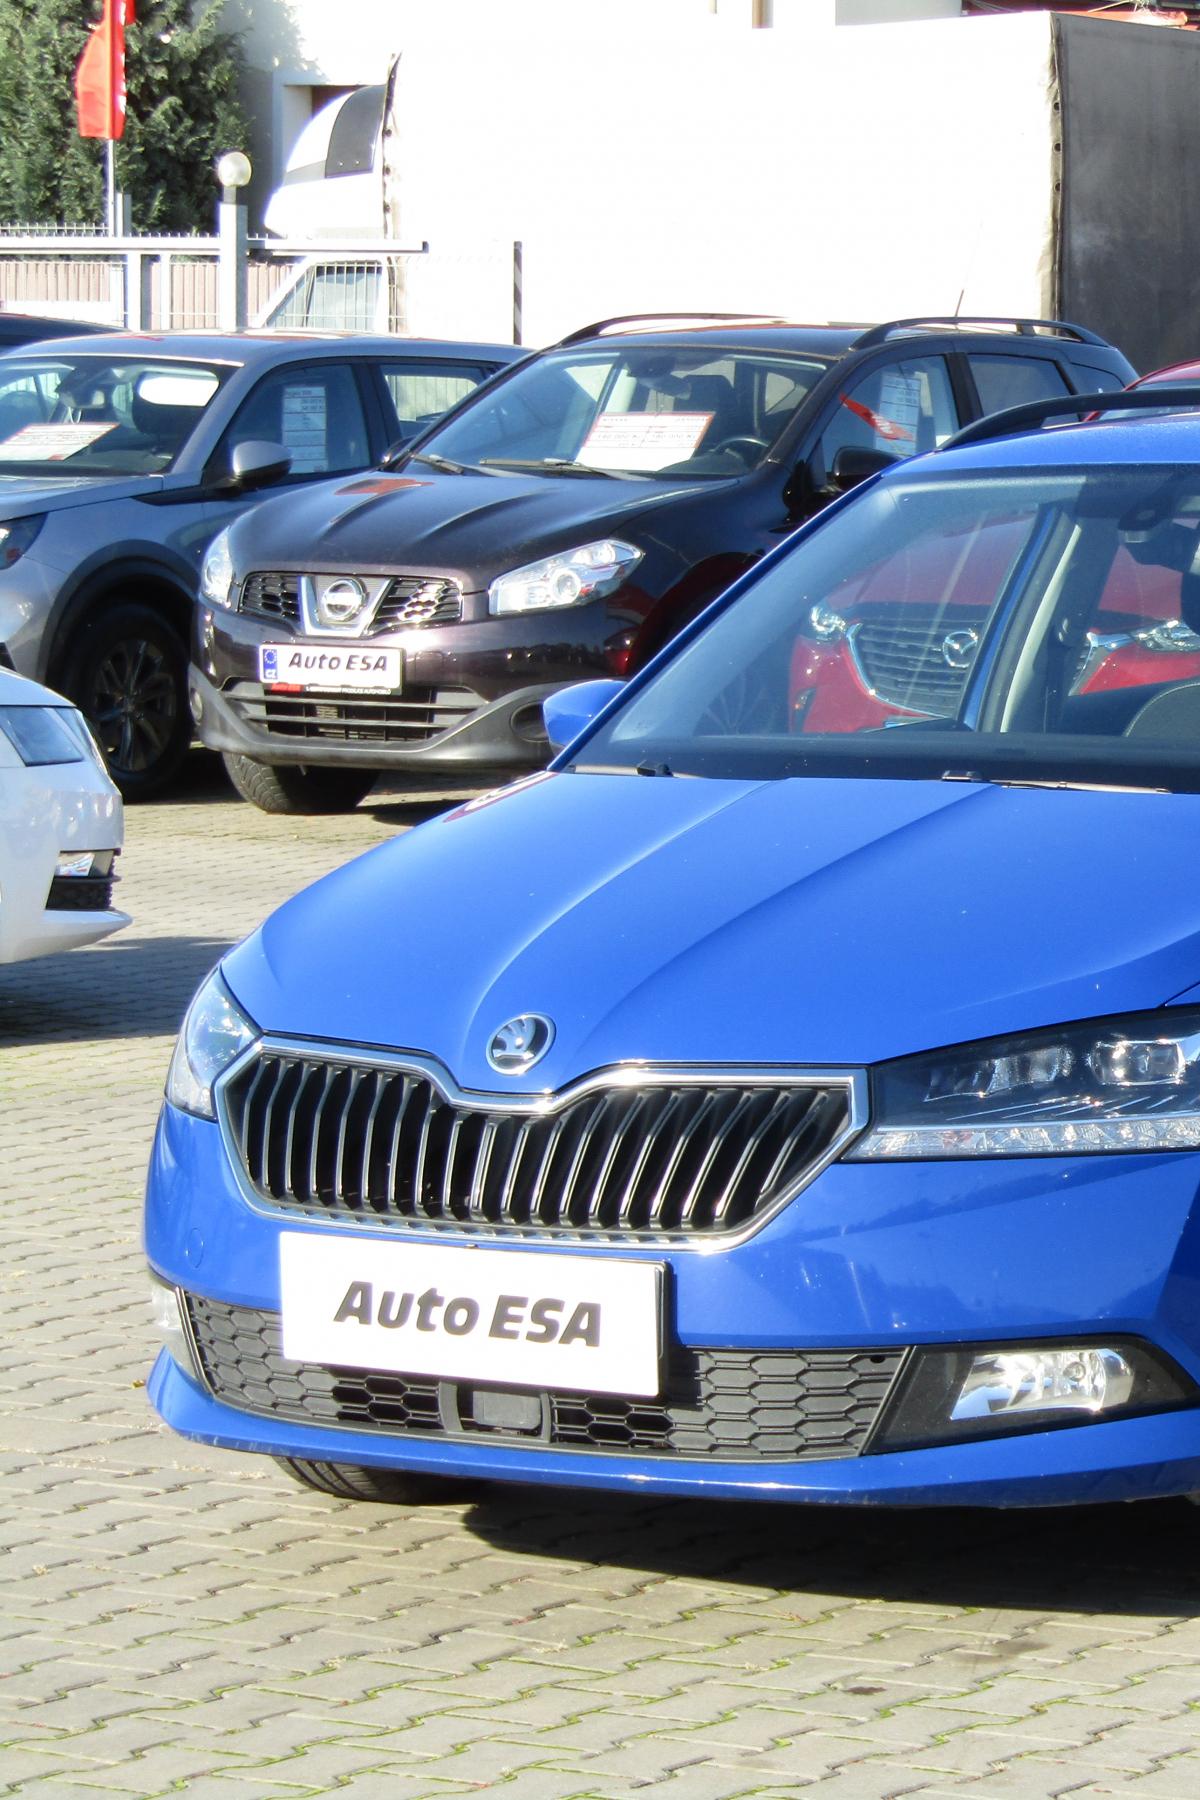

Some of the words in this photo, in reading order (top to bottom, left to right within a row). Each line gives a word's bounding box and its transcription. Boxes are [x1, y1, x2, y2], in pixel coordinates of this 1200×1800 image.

[288, 652, 341, 670] Auto
[346, 654, 388, 672] ESA
[333, 1281, 480, 1336] Auto
[488, 1295, 600, 1347] ESA
